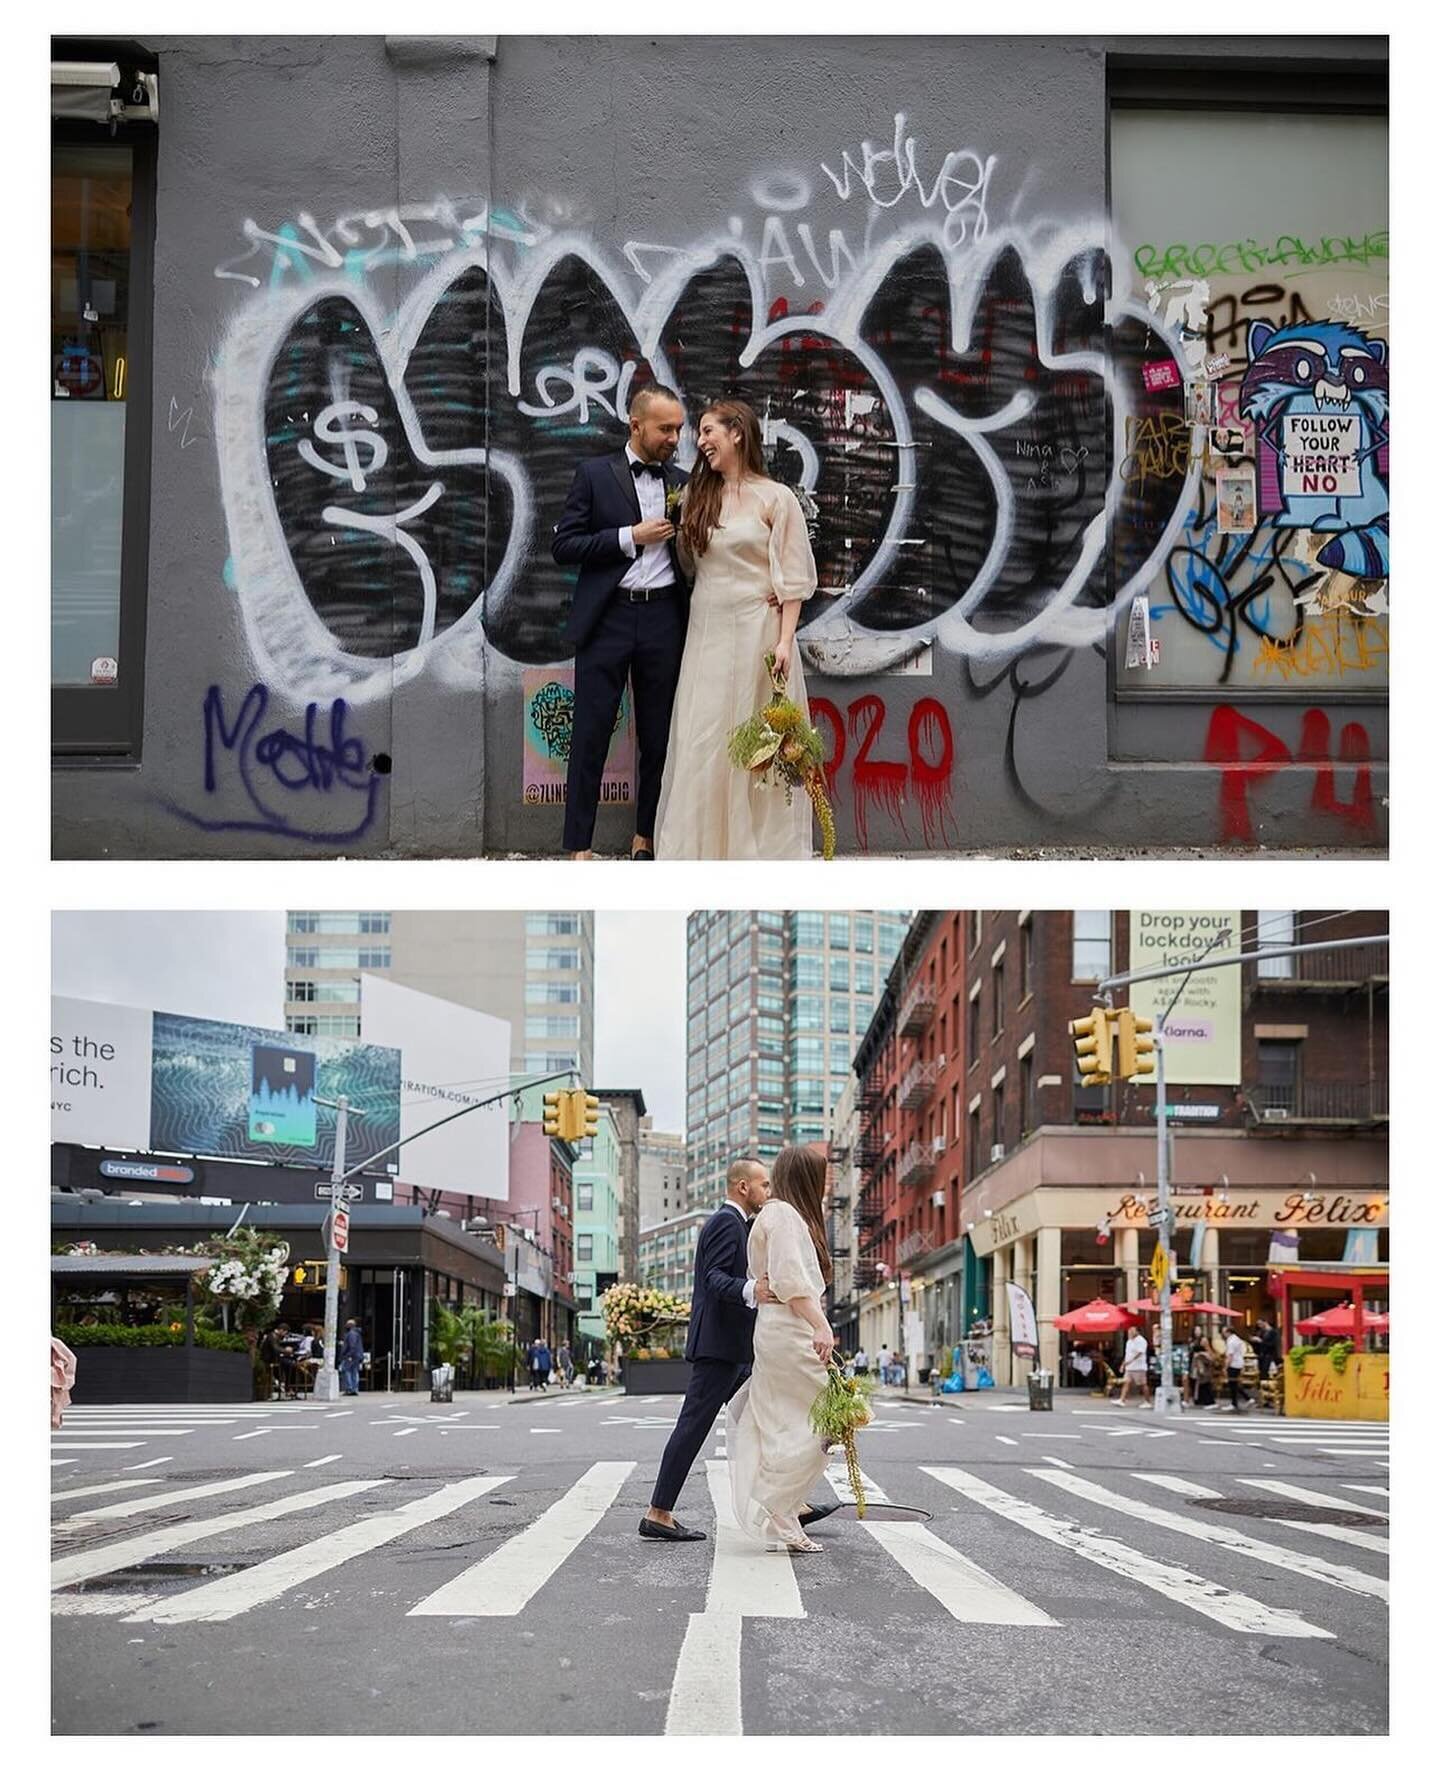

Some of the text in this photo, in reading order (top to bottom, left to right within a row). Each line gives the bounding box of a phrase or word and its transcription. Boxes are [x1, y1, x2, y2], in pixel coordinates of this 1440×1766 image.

[1291, 418, 1353, 433] FOLLOW
[1016, 440, 1053, 456] Nina
[1300, 436, 1340, 451] YOUR
[1293, 455, 1351, 474] HEART
[1303, 474, 1338, 493] NO
[1140, 912, 1232, 931] Drop your
[72, 1036, 115, 1060] the
[51, 1062, 104, 1089] rich.
[107, 1164, 158, 1177] branded
